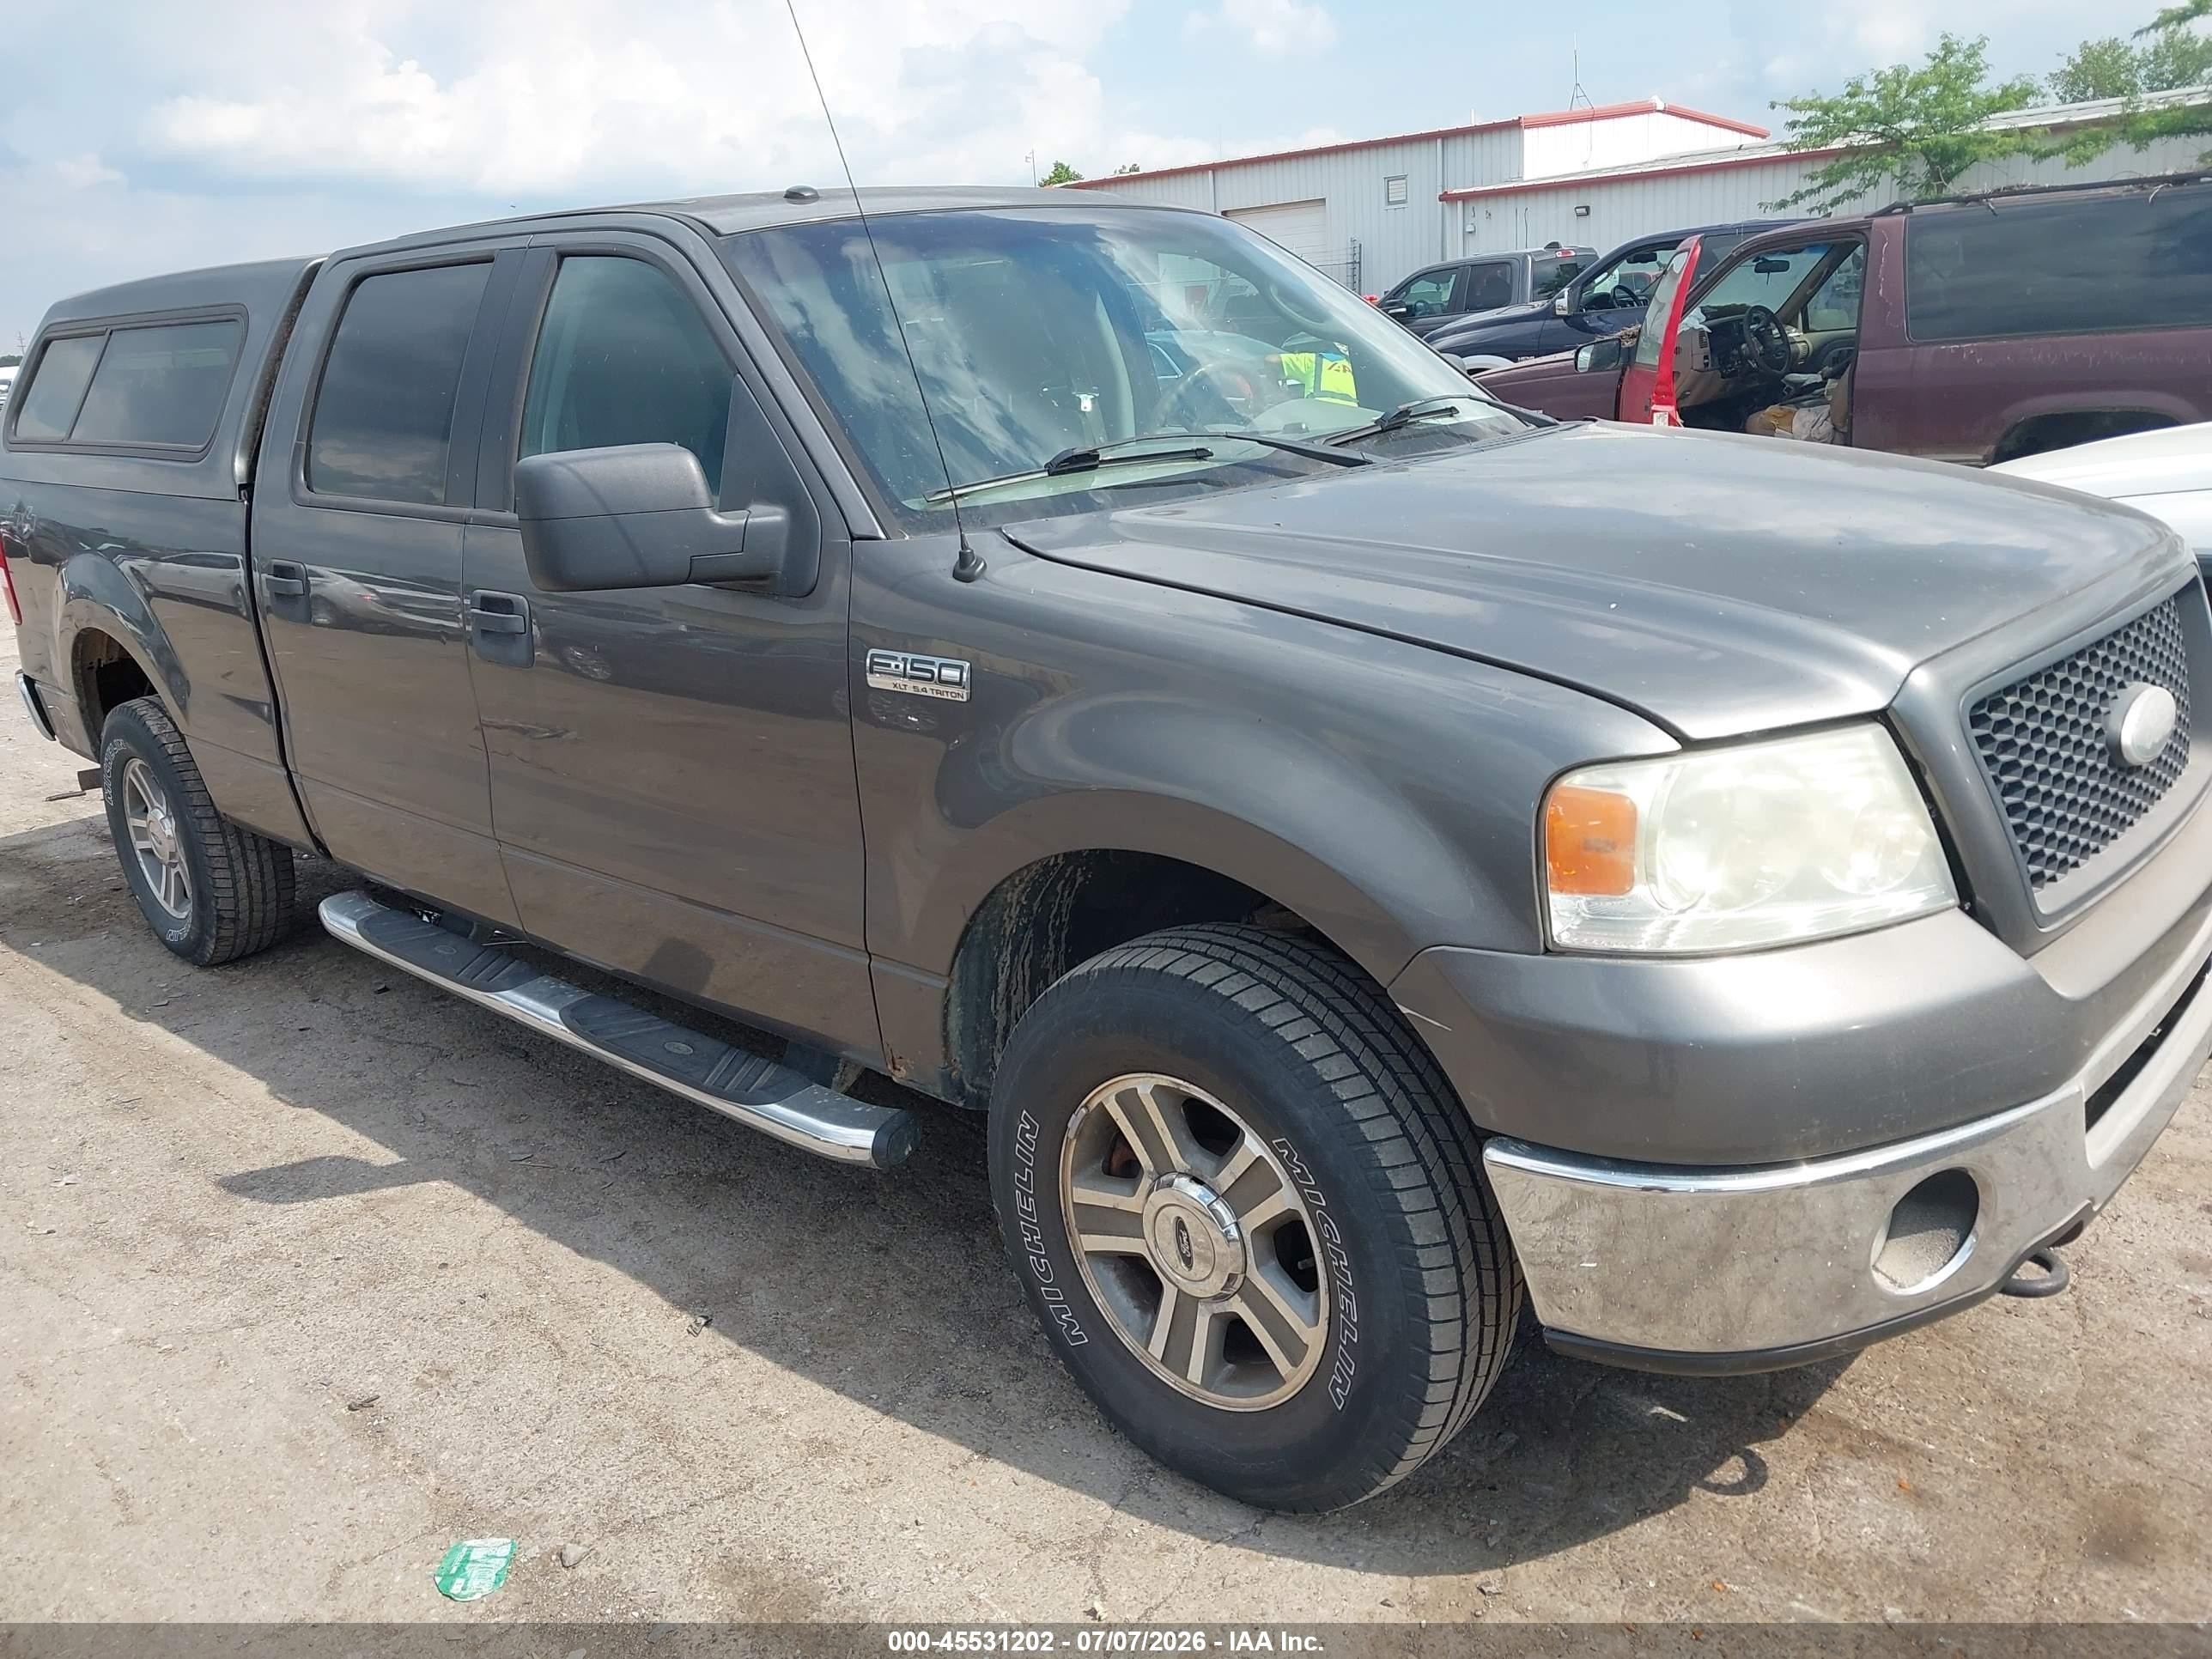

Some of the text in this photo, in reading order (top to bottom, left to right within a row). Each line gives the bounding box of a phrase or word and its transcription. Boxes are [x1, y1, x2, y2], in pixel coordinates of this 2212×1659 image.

[892, 682, 964, 700] XLT 5.4 TRITON
[103, 738, 127, 806] MICHELIN
[1013, 1109, 1089, 1346] MICHELIN
[1178, 1229, 1191, 1258] Ford
[1272, 1137, 1358, 1411] MICHELIN
